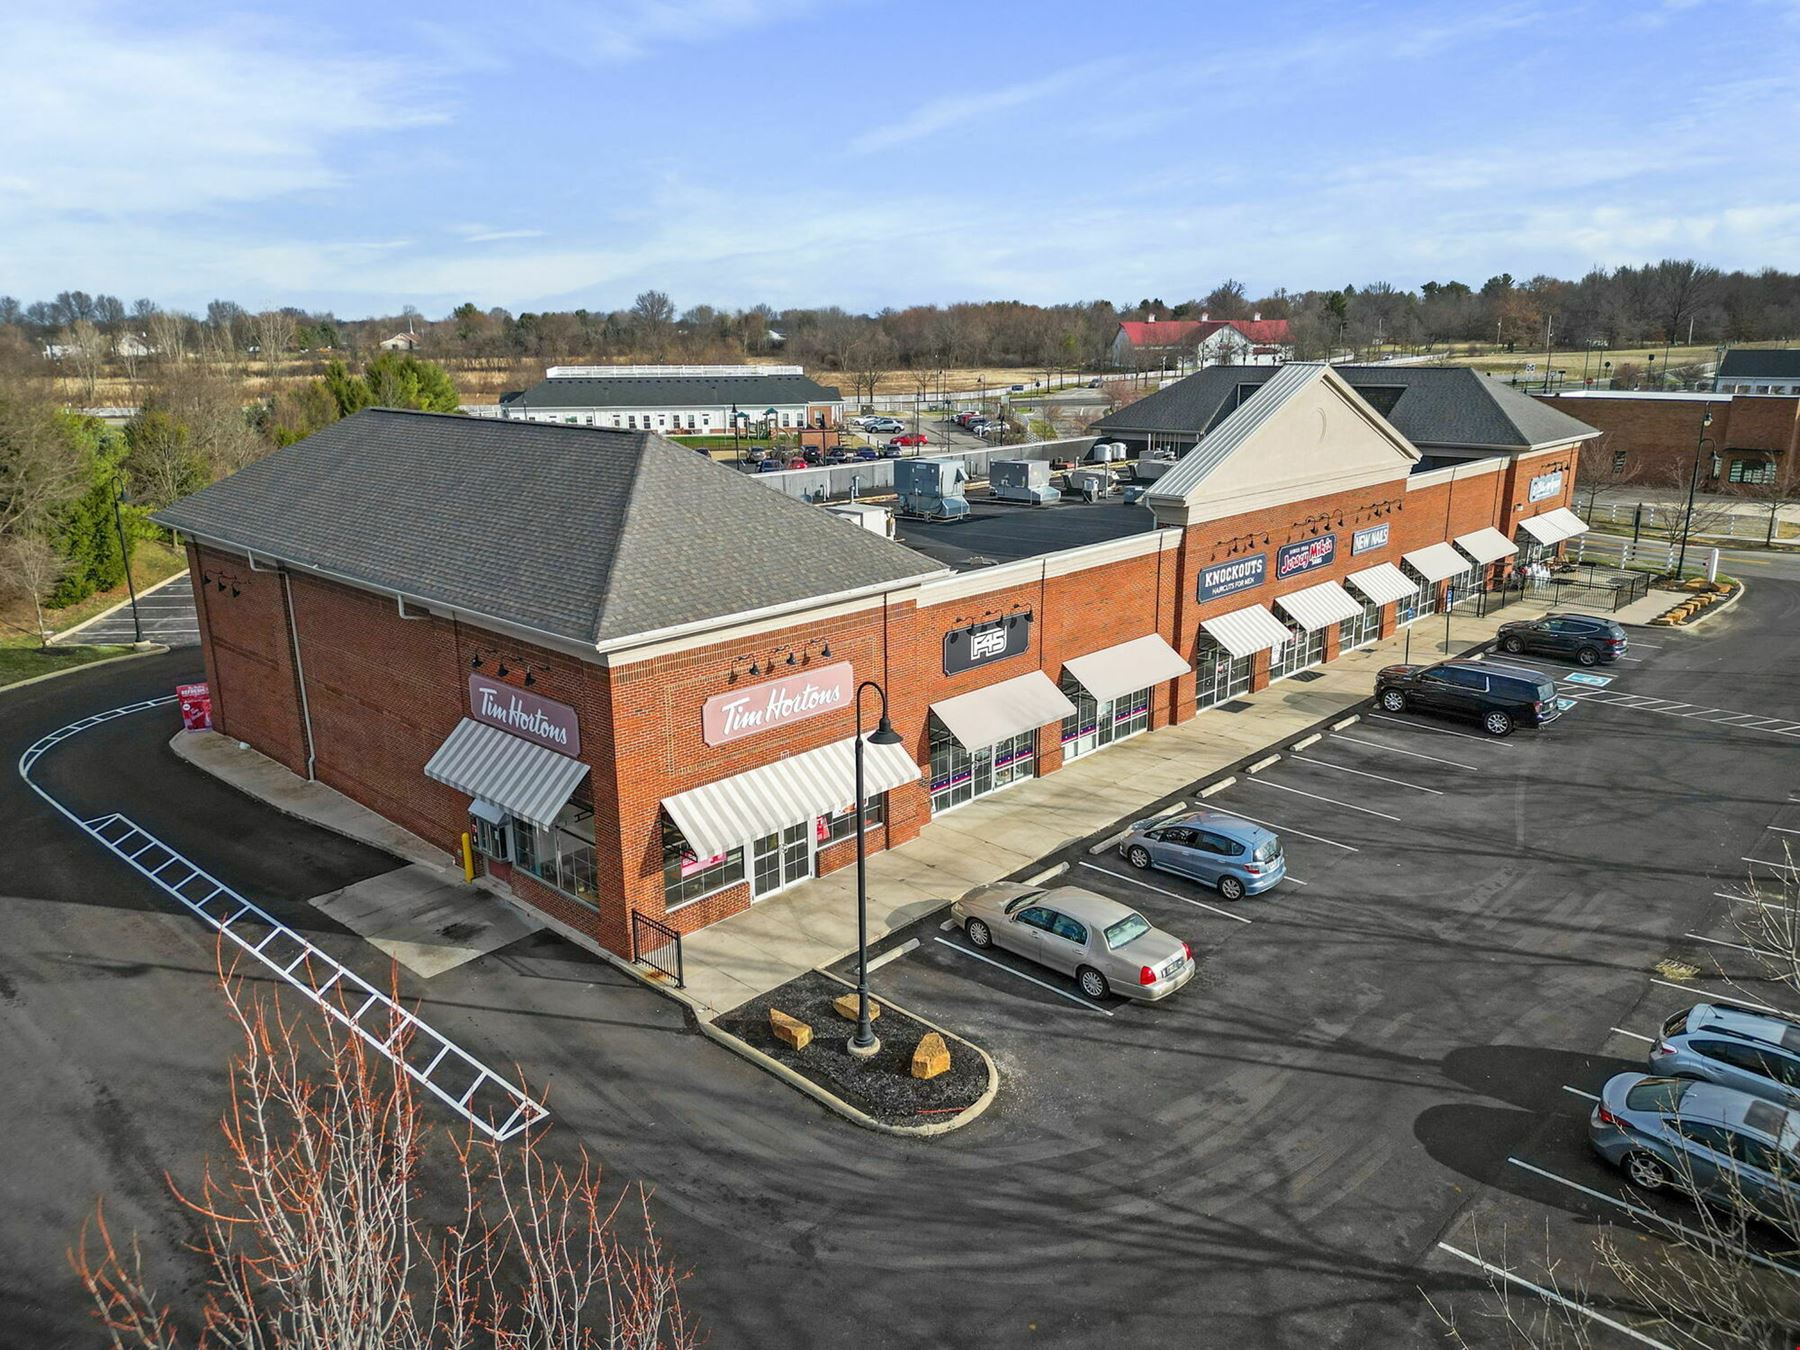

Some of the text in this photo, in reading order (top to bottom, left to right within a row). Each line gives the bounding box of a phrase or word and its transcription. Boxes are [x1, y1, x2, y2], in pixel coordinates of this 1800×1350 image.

[1281, 537, 1333, 574] Jersey Mike's
[1355, 528, 1387, 551] NEW NAILS
[1205, 559, 1263, 587] KNOCKOUTS
[1212, 582, 1235, 595] HAIRCUTS
[971, 626, 1007, 660] F45
[479, 688, 567, 745] Tim Hortons
[721, 683, 840, 735] Tim Hortons
